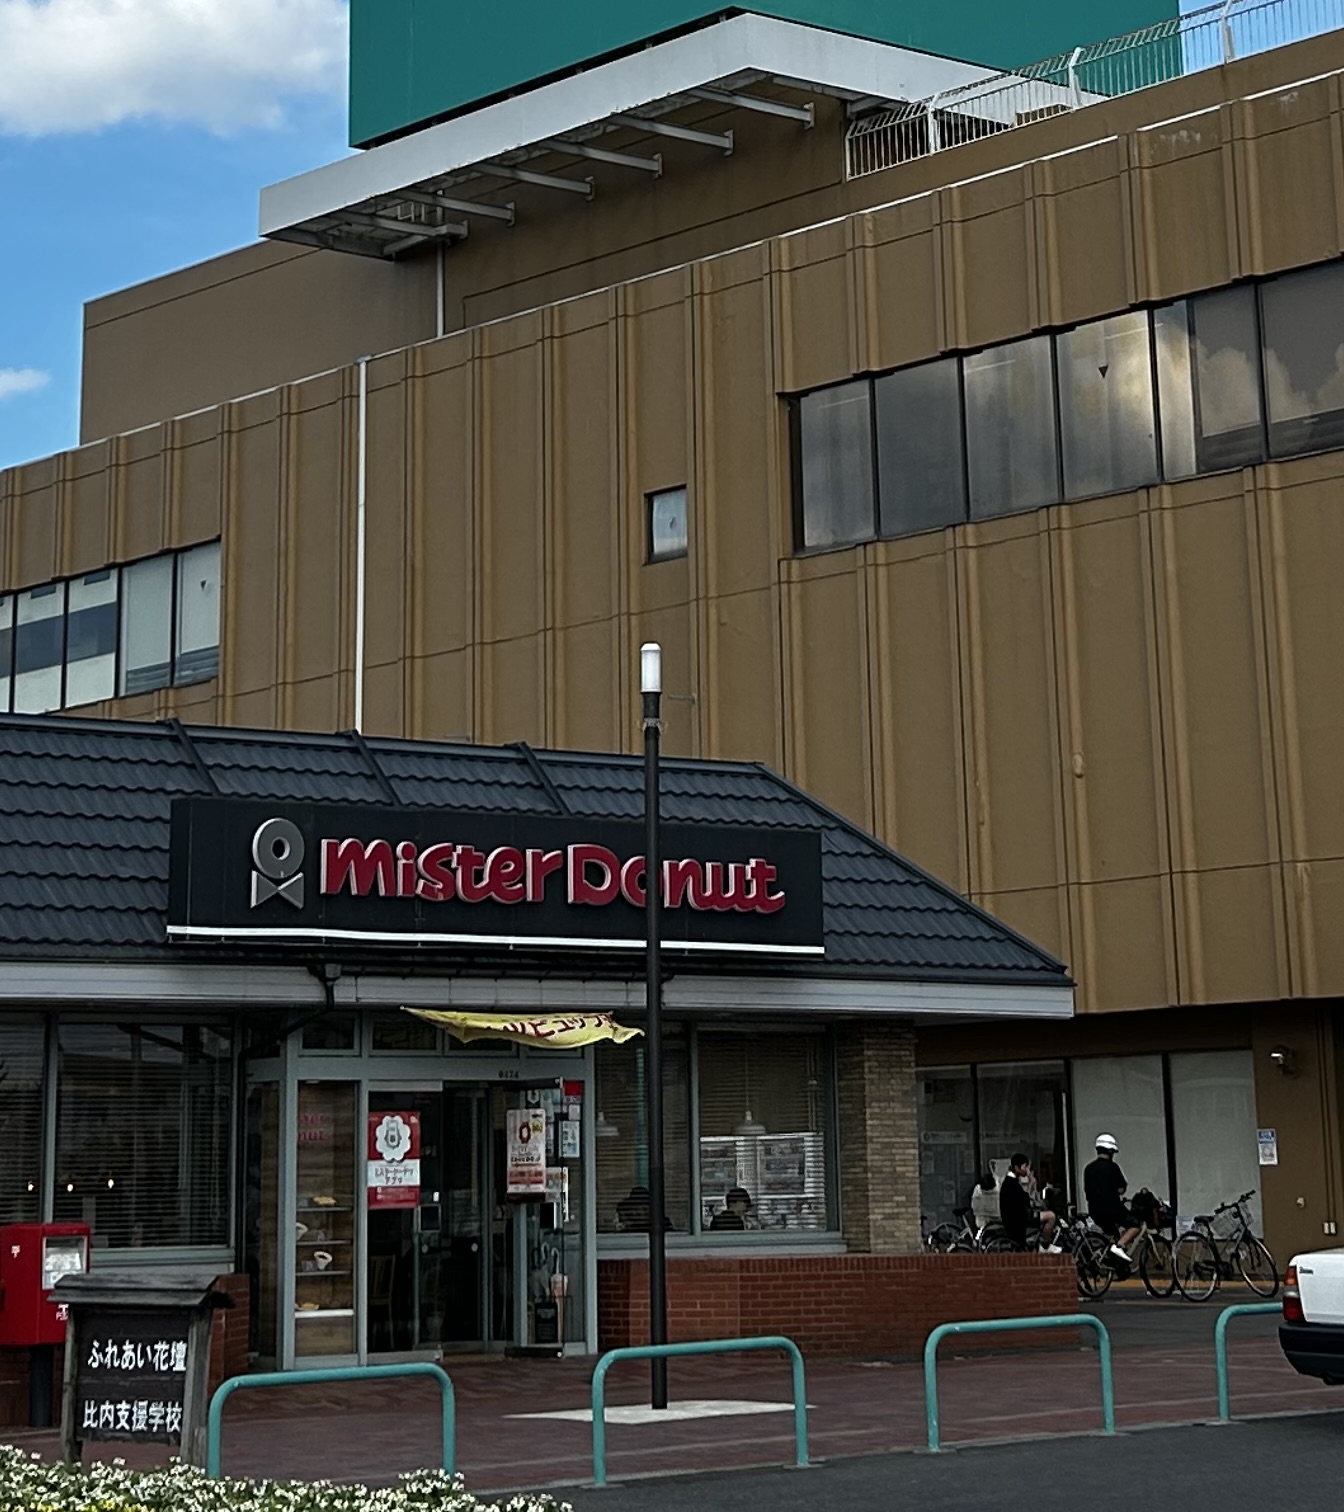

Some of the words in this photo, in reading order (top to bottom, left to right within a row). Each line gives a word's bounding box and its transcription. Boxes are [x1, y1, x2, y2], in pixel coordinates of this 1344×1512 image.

[566, 843, 786, 914] Donut
[88, 1339, 188, 1372] ふれあい花壇
[83, 1399, 183, 1433] 比内支援学校
